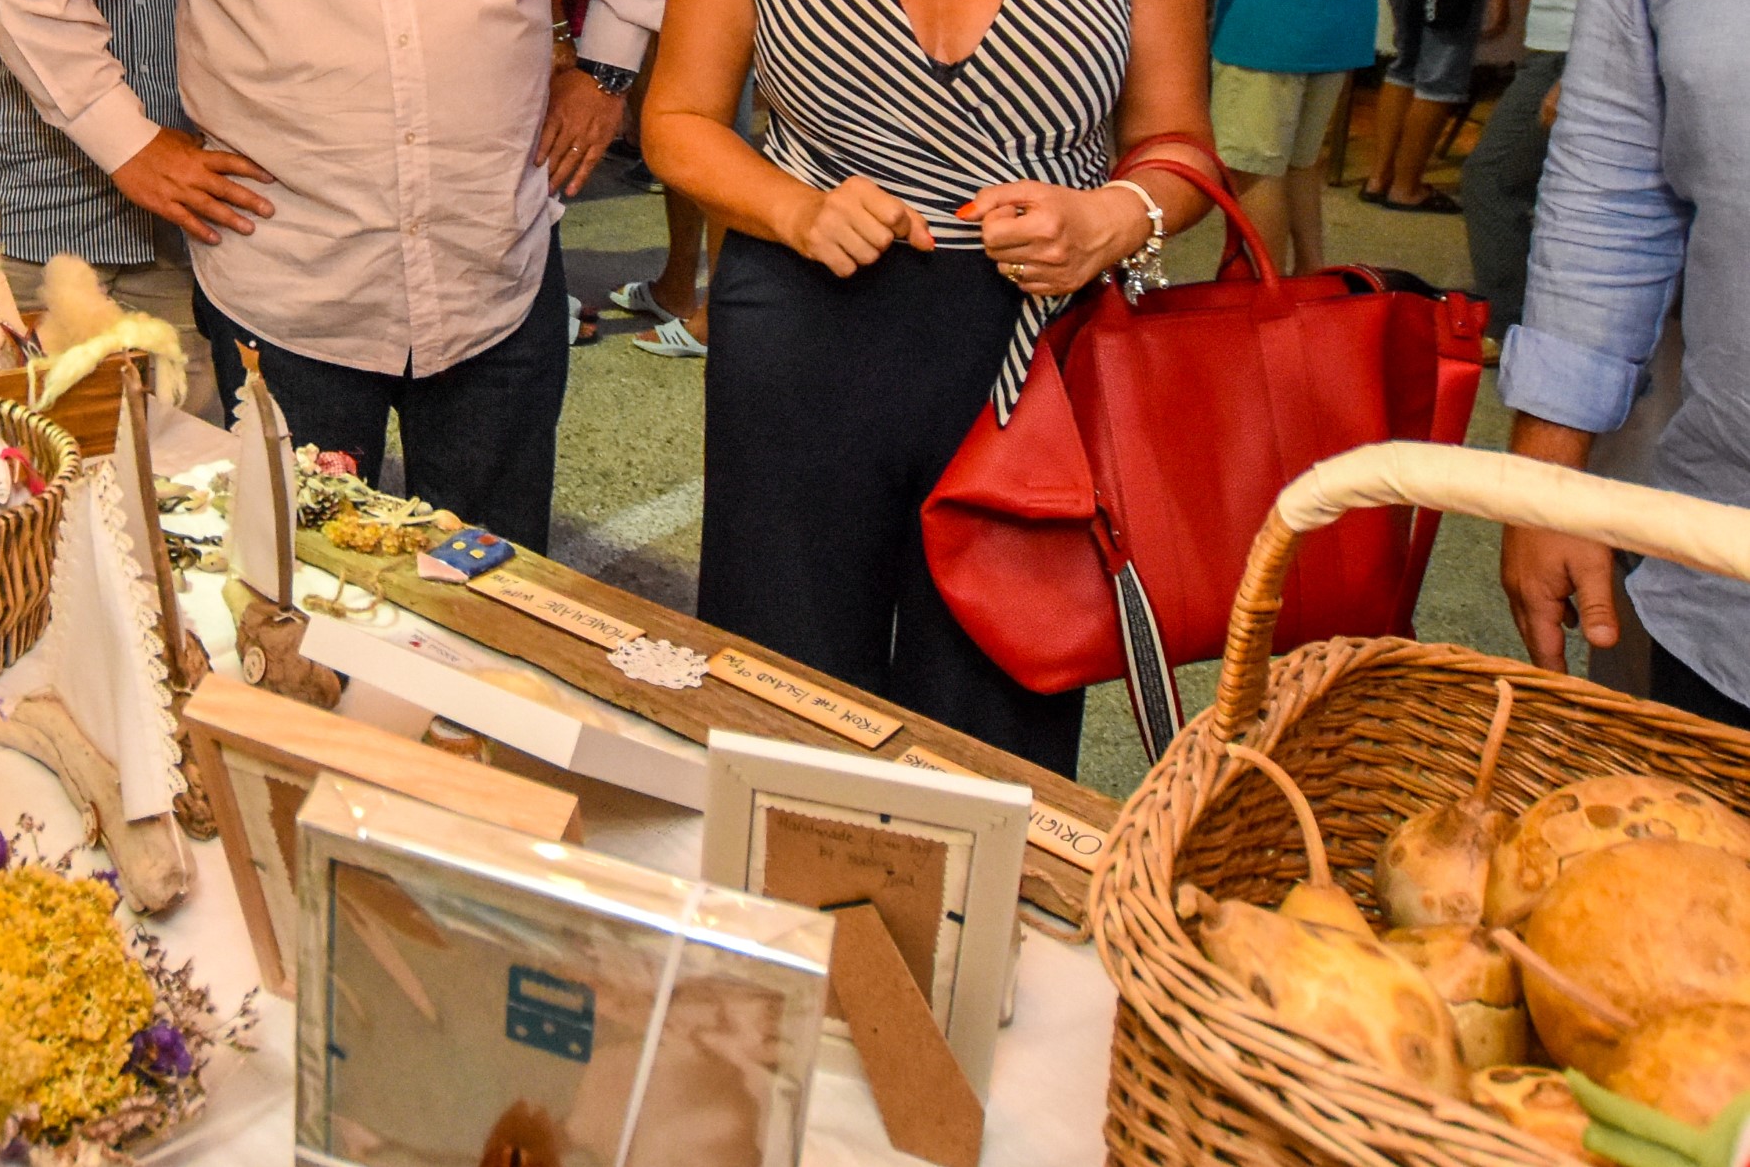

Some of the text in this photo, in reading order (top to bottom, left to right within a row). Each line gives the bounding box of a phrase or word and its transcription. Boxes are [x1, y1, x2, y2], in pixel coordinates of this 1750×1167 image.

[538, 599, 629, 641] HOMEMADE
[737, 667, 751, 678] OF
[756, 671, 810, 703] ISLAND
[811, 696, 838, 713] THE
[840, 709, 883, 736] FROM
